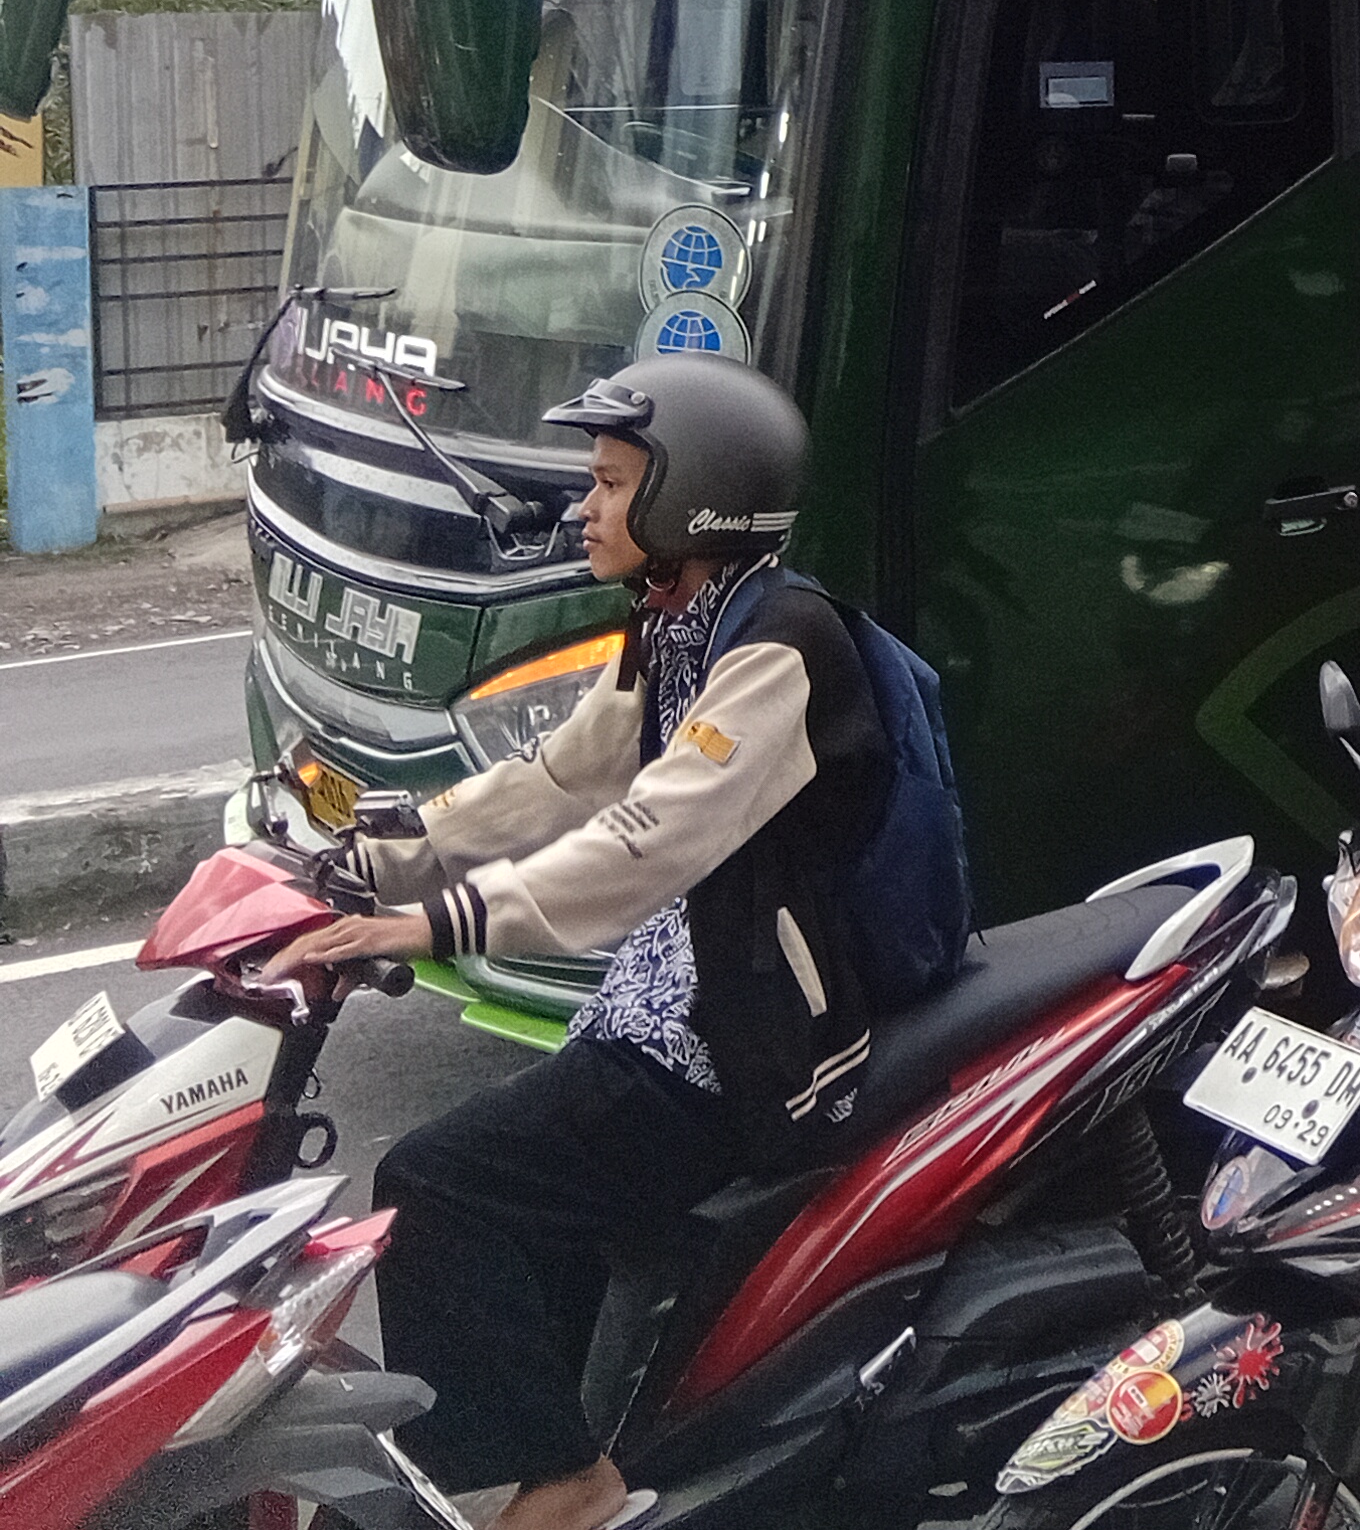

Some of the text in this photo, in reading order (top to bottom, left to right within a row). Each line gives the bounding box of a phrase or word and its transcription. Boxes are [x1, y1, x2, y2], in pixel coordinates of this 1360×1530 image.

[688, 508, 751, 535] Classic
[324, 586, 422, 665] JAYA
[1223, 1021, 1268, 1064] AA
[1262, 1036, 1332, 1086] 6455
[160, 1067, 249, 1115] YAMAHA
